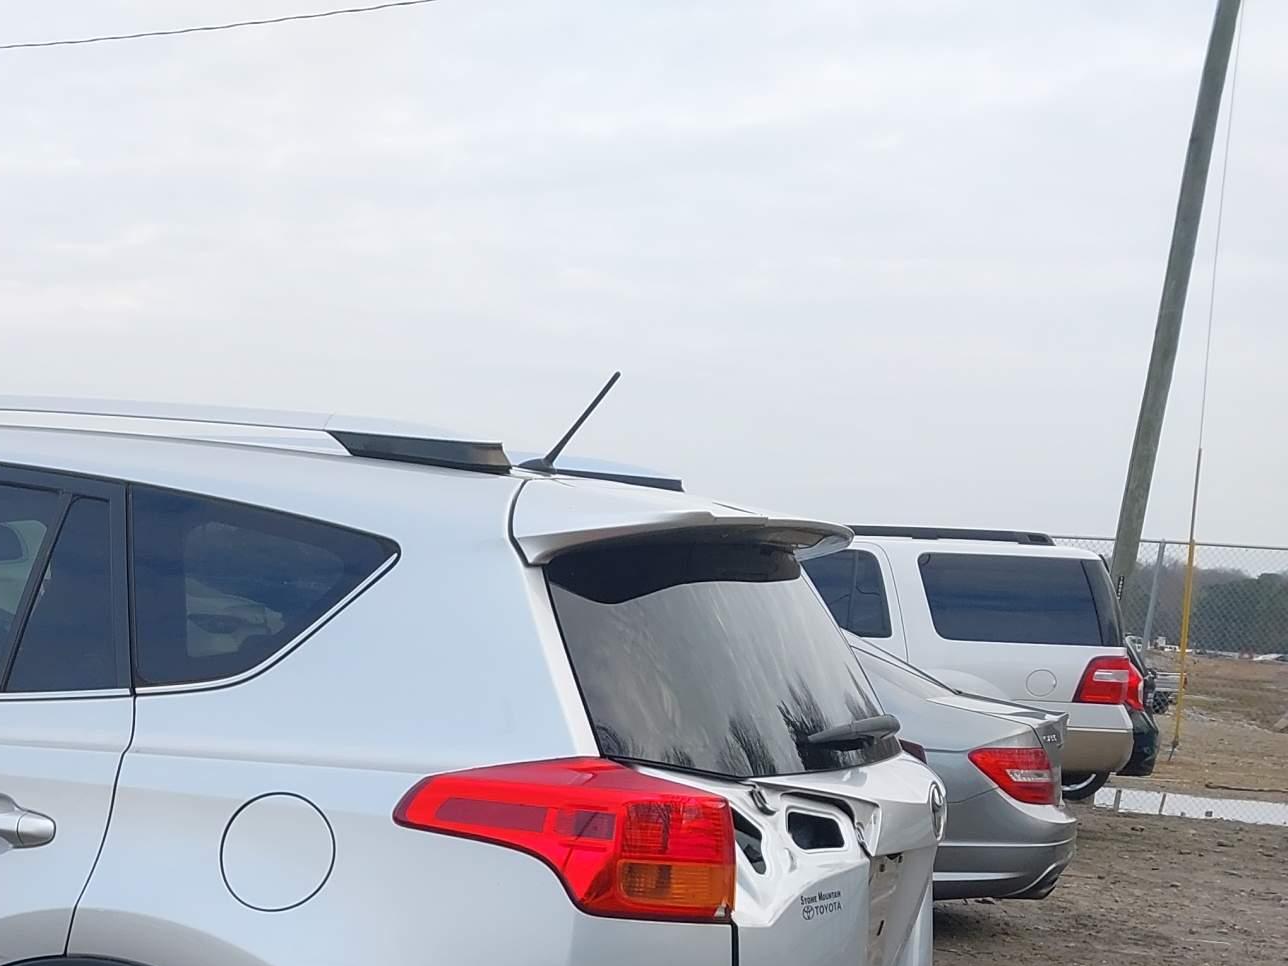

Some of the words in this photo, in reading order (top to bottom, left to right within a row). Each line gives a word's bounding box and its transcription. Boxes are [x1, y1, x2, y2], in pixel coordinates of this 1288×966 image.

[800, 895, 817, 905] STONE
[817, 890, 841, 901] MOUNTAIN
[814, 901, 842, 916] TOYOTA
